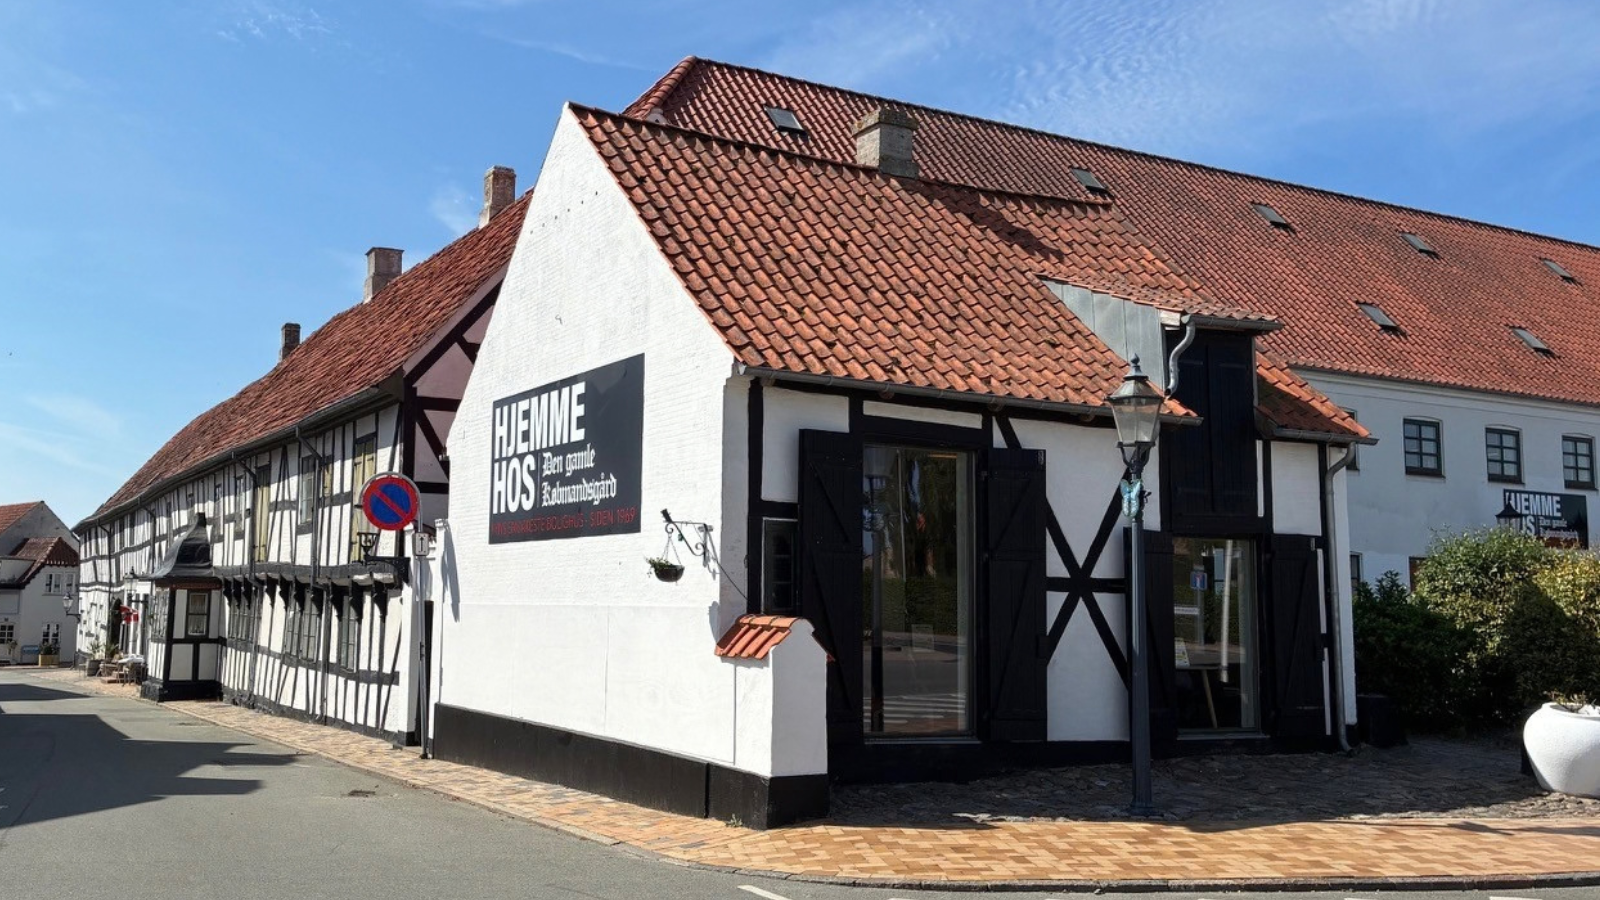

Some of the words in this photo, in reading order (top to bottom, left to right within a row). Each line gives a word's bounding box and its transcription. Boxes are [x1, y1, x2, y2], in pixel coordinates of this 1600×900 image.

[494, 381, 586, 459] HJEMME
[493, 454, 536, 514] HOS
[542, 451, 564, 478] Den
[565, 443, 596, 477] gamle
[590, 509, 614, 528] SIDEN
[617, 506, 638, 523] 1969
